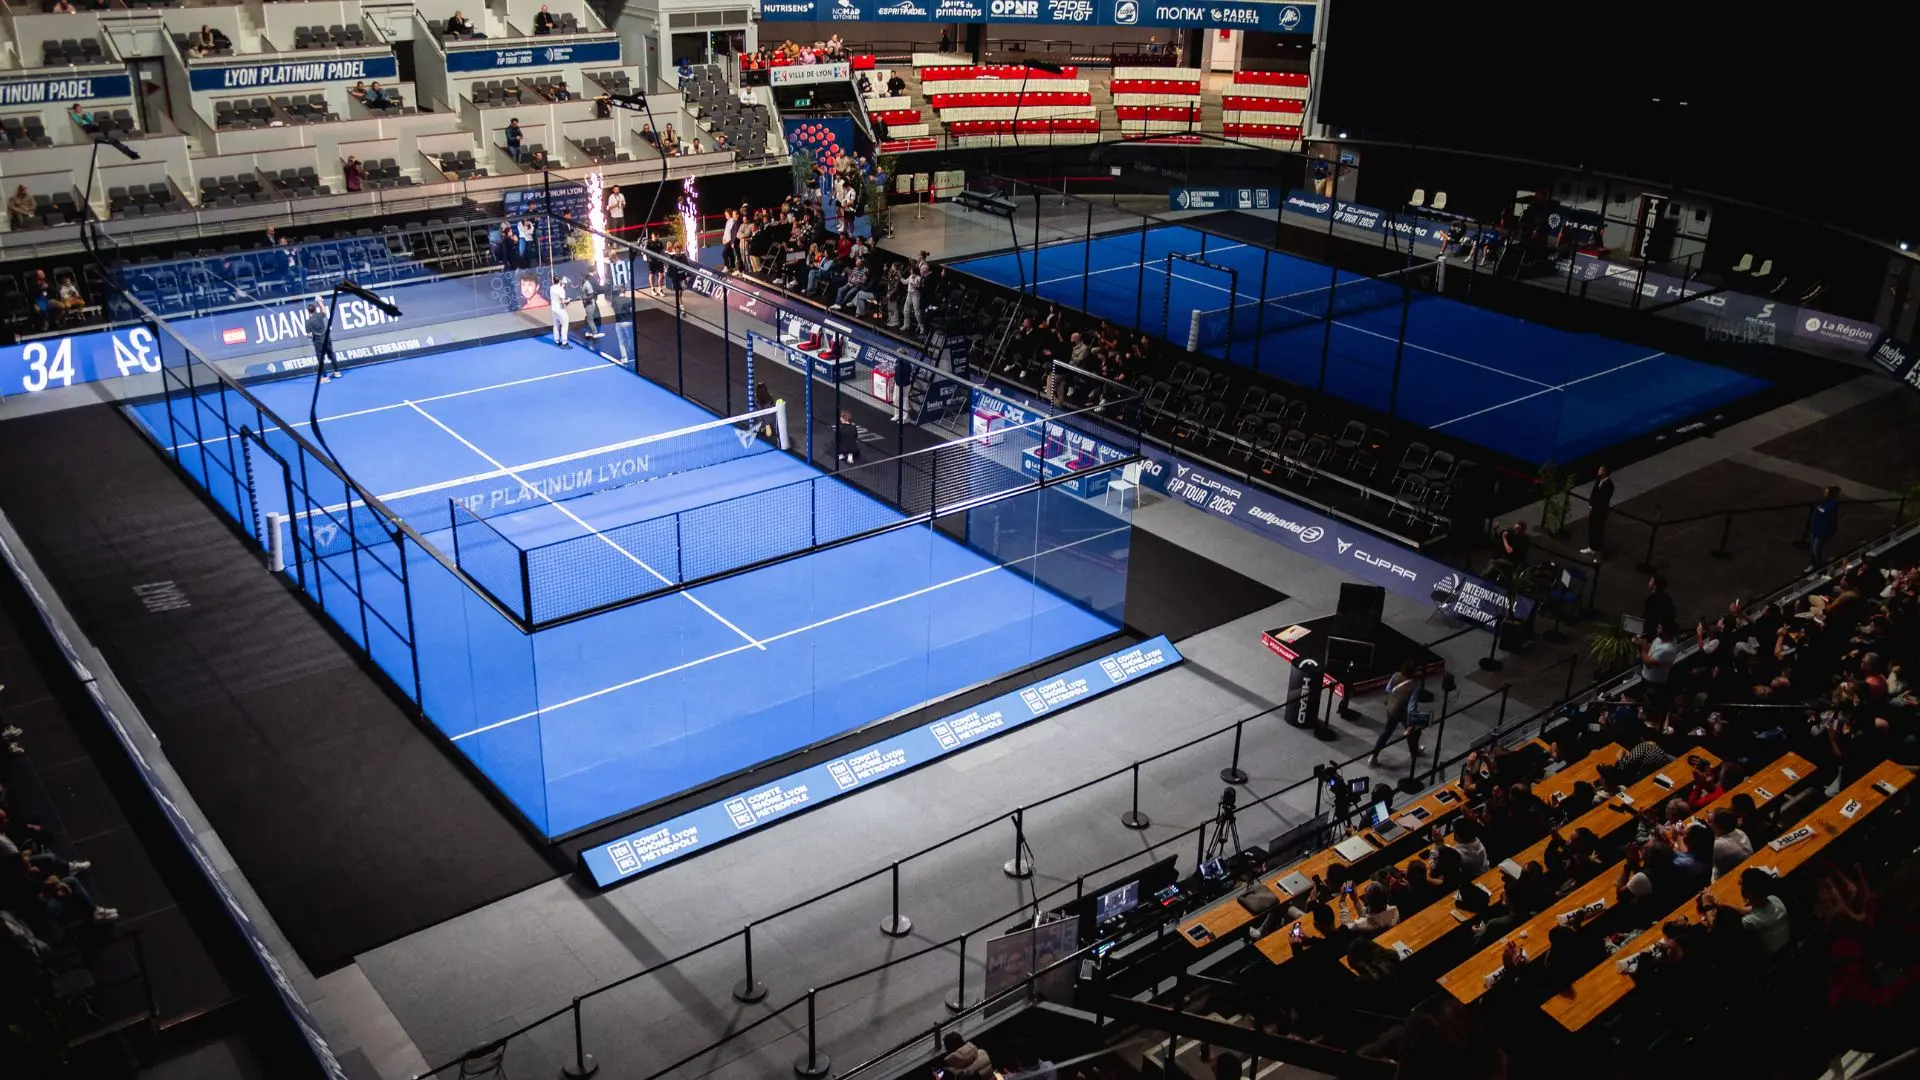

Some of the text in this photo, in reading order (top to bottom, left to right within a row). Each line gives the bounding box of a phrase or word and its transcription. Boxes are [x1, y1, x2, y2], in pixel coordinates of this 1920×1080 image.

[764, 4, 808, 12] NUTRISENS
[936, 8, 982, 19] printemps
[1048, 0, 1093, 11] PADEL
[1223, 9, 1259, 19] PADEL
[1053, 10, 1092, 21] SHOT
[225, 60, 366, 86] LYON PLATINUM PADEL
[788, 69, 832, 79] VILLE DE LYON
[50, 79, 95, 99] PADEL
[535, 188, 566, 199] PLAINUM
[567, 186, 583, 195] LYON
[1823, 320, 1873, 340] La Région
[348, 347, 371, 361] PADEL
[373, 339, 421, 356] FEDERATION
[22, 337, 75, 392] 34
[491, 468, 593, 509] PLATINUM
[599, 455, 649, 483] LYON
[1190, 473, 1242, 499] CUPRA
[1167, 477, 1237, 515] FIP TOUR 2025
[1247, 506, 1305, 535] Bullpadel
[1354, 549, 1418, 582] CUPRA
[1459, 591, 1481, 609] PADEL
[1462, 582, 1518, 613] INTERNATIONL
[1453, 602, 1498, 628] FEDERATION
[1144, 648, 1162, 660] LYON
[1067, 678, 1087, 690] LYON
[1297, 676, 1312, 724] HEAD
[981, 711, 1002, 724] LYON
[883, 748, 905, 761] LYON
[783, 784, 808, 800] LYON
[671, 826, 698, 842] LYON
[1777, 828, 1809, 846] HEAD
